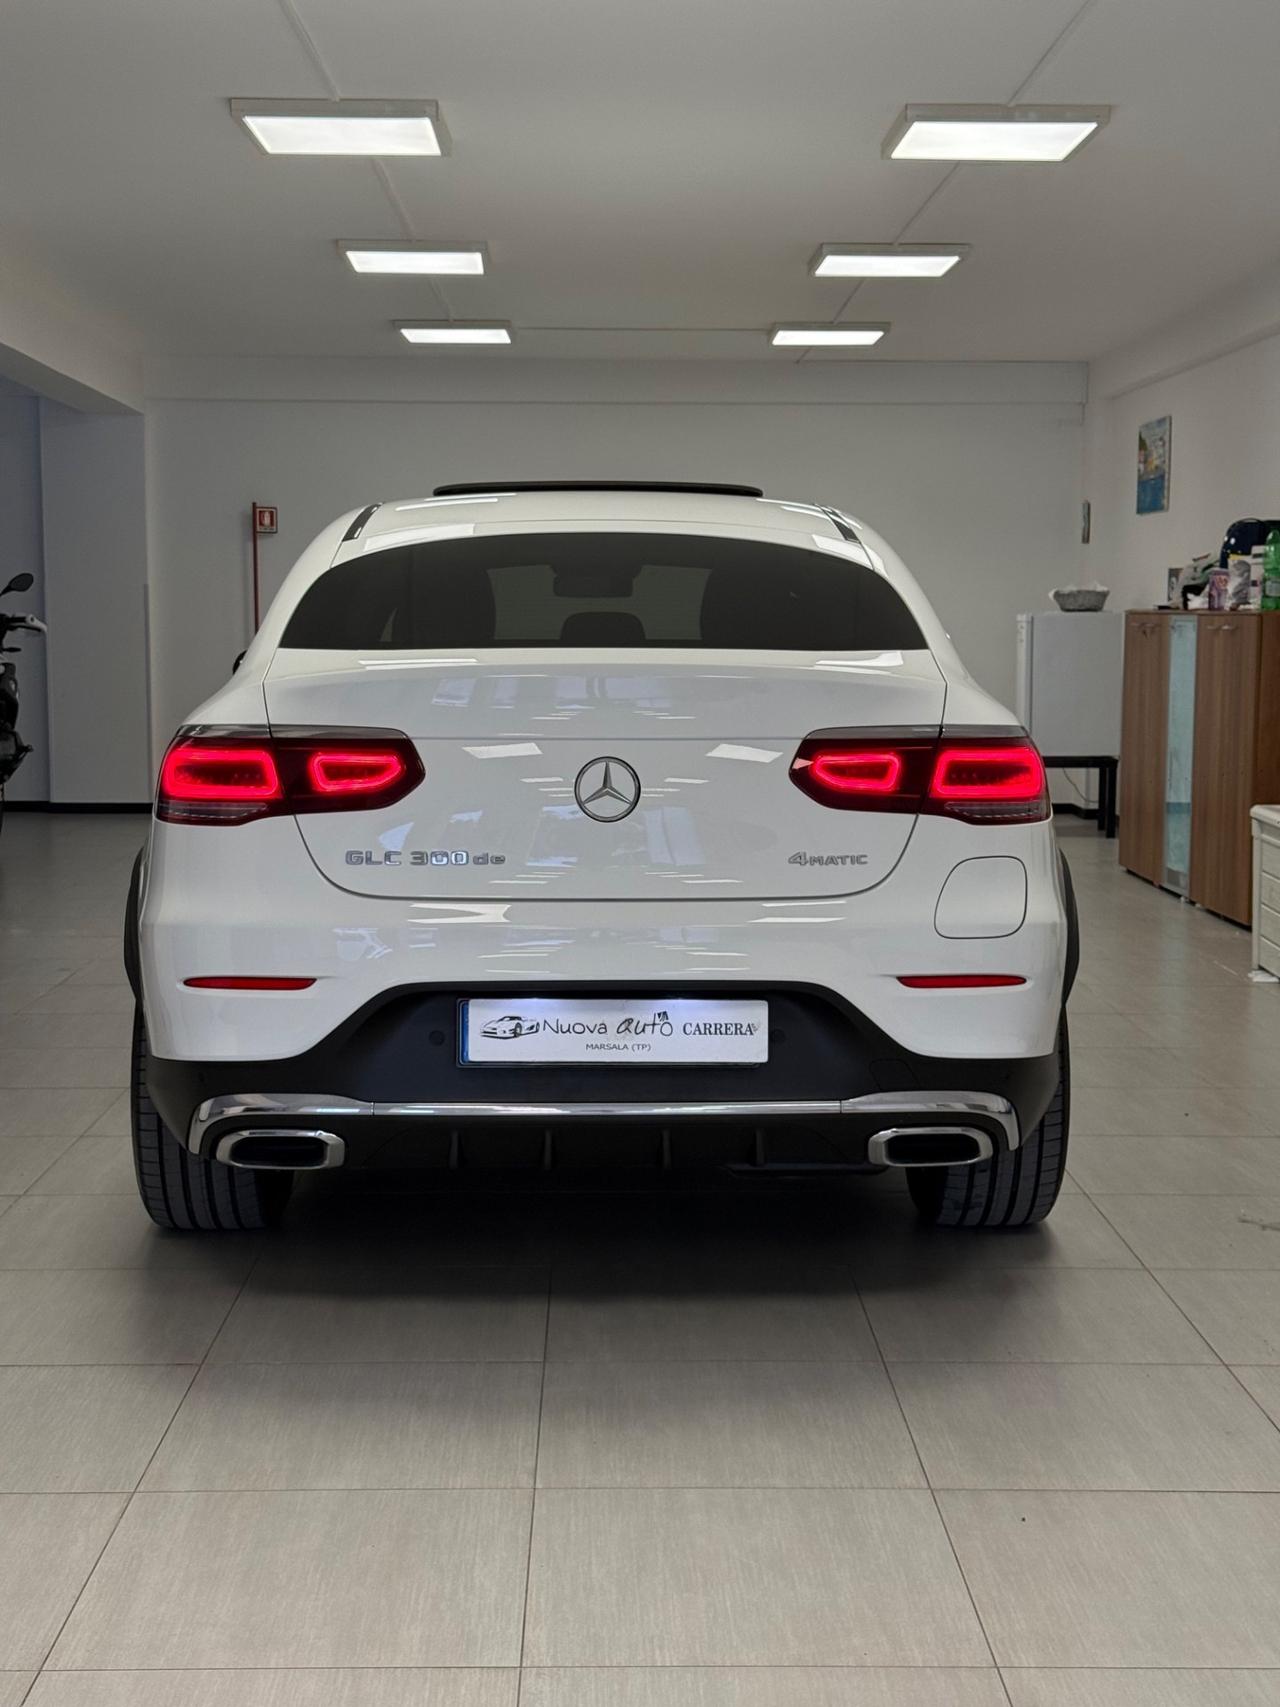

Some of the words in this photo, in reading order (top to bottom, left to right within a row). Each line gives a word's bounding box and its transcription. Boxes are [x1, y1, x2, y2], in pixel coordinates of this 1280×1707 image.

[345, 850, 402, 866] GLC
[409, 850, 469, 866] 300
[472, 852, 506, 866] de
[788, 851, 868, 866] 4MATIC
[543, 1018, 608, 1036] Nuova
[683, 1022, 755, 1036] CARRERA
[586, 1043, 629, 1051] MARSALA
[631, 1043, 652, 1052] (TP)
